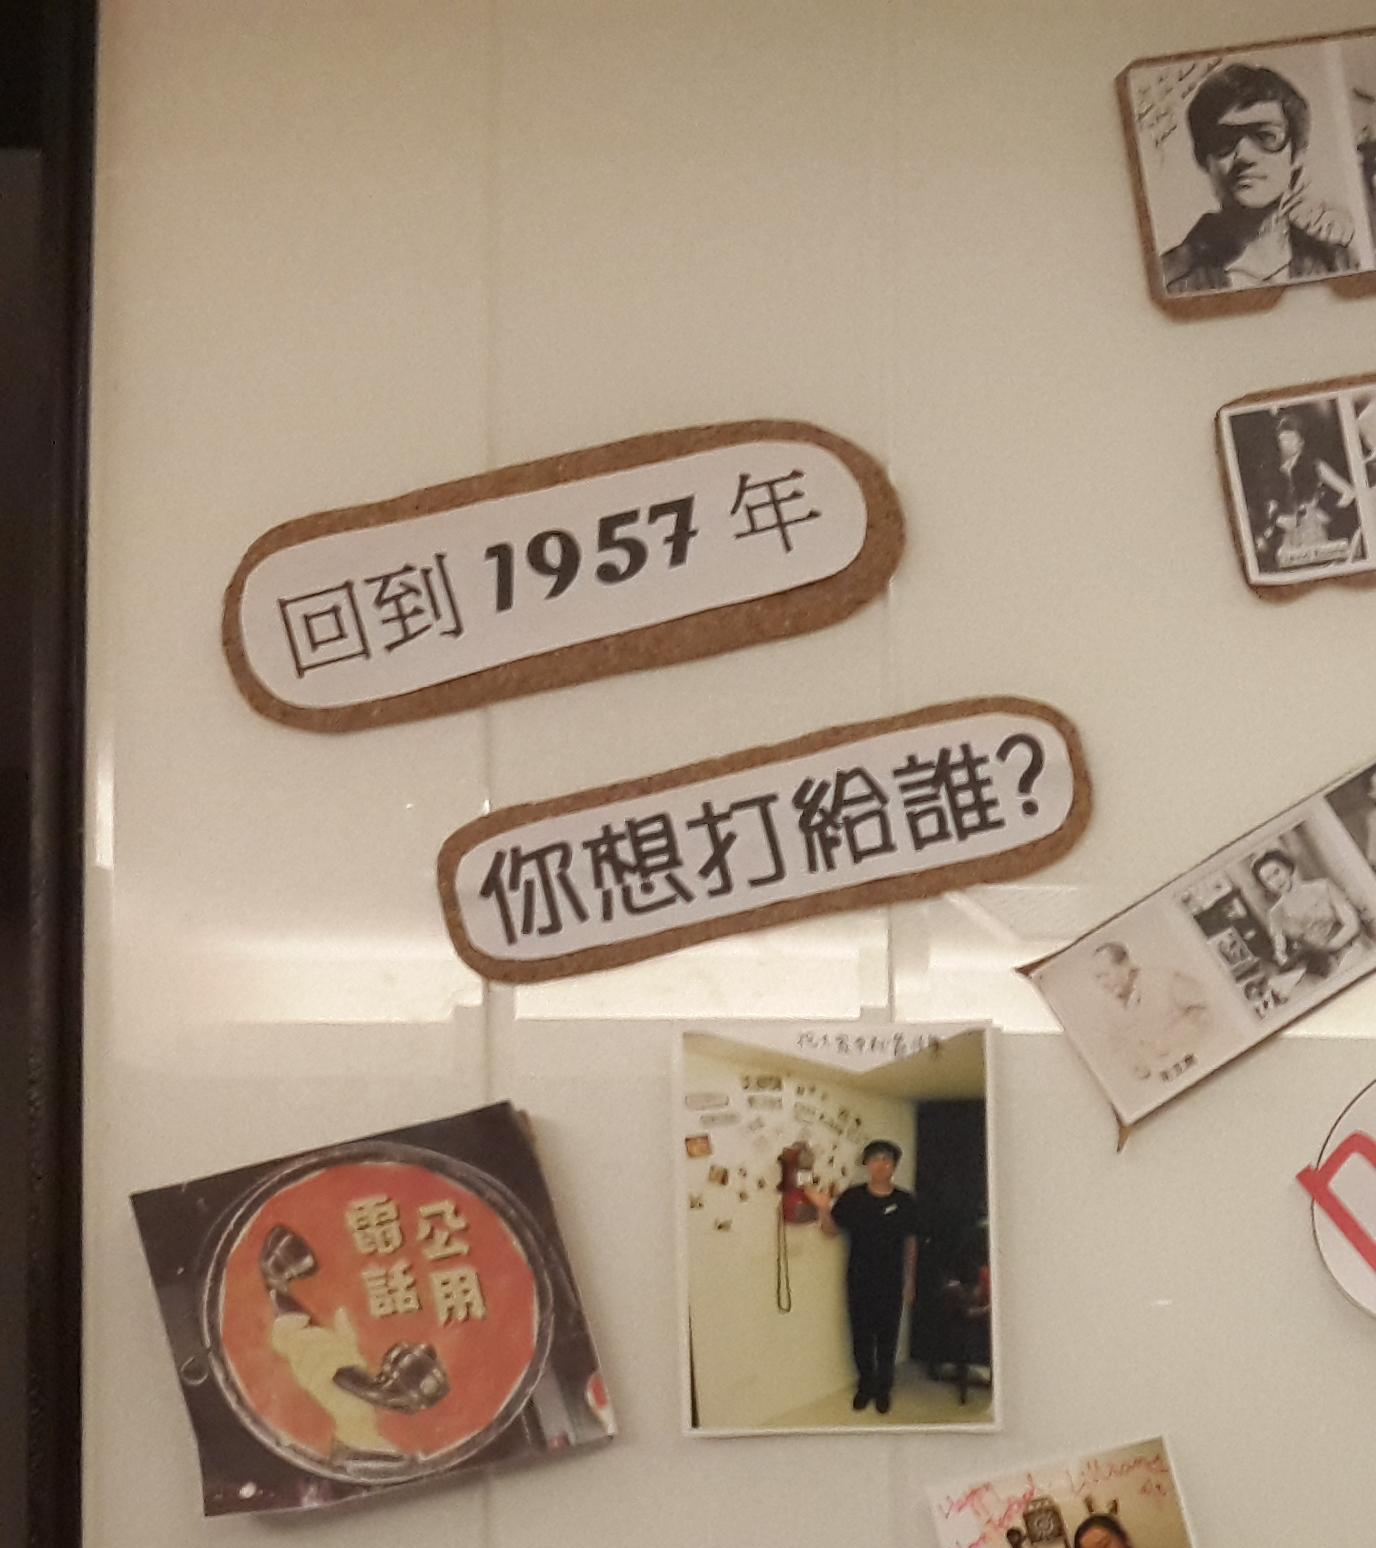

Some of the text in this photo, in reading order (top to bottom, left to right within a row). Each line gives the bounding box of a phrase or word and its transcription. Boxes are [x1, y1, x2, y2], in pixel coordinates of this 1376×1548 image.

[278, 467, 821, 680] 回到 1957 年
[477, 732, 1049, 946] 你想打給誰?
